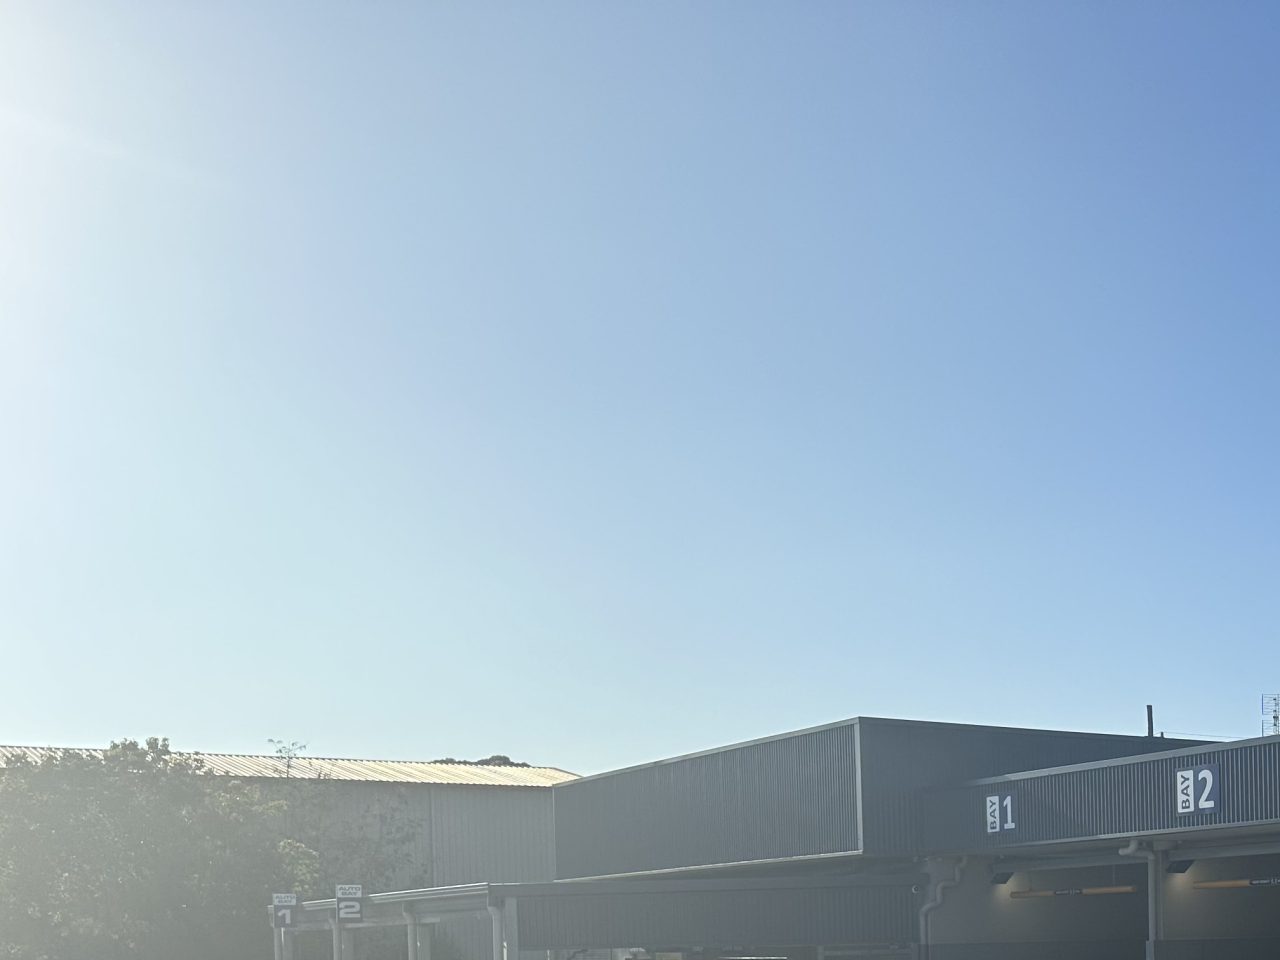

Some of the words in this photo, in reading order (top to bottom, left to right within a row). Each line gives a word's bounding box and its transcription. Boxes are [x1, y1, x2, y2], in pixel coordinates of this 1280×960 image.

[1180, 774, 1191, 810] BAY
[1198, 769, 1215, 809] 2
[989, 799, 997, 830] BAY
[1003, 795, 1016, 830] 1
[277, 908, 292, 924] 1
[338, 901, 361, 918] 2
